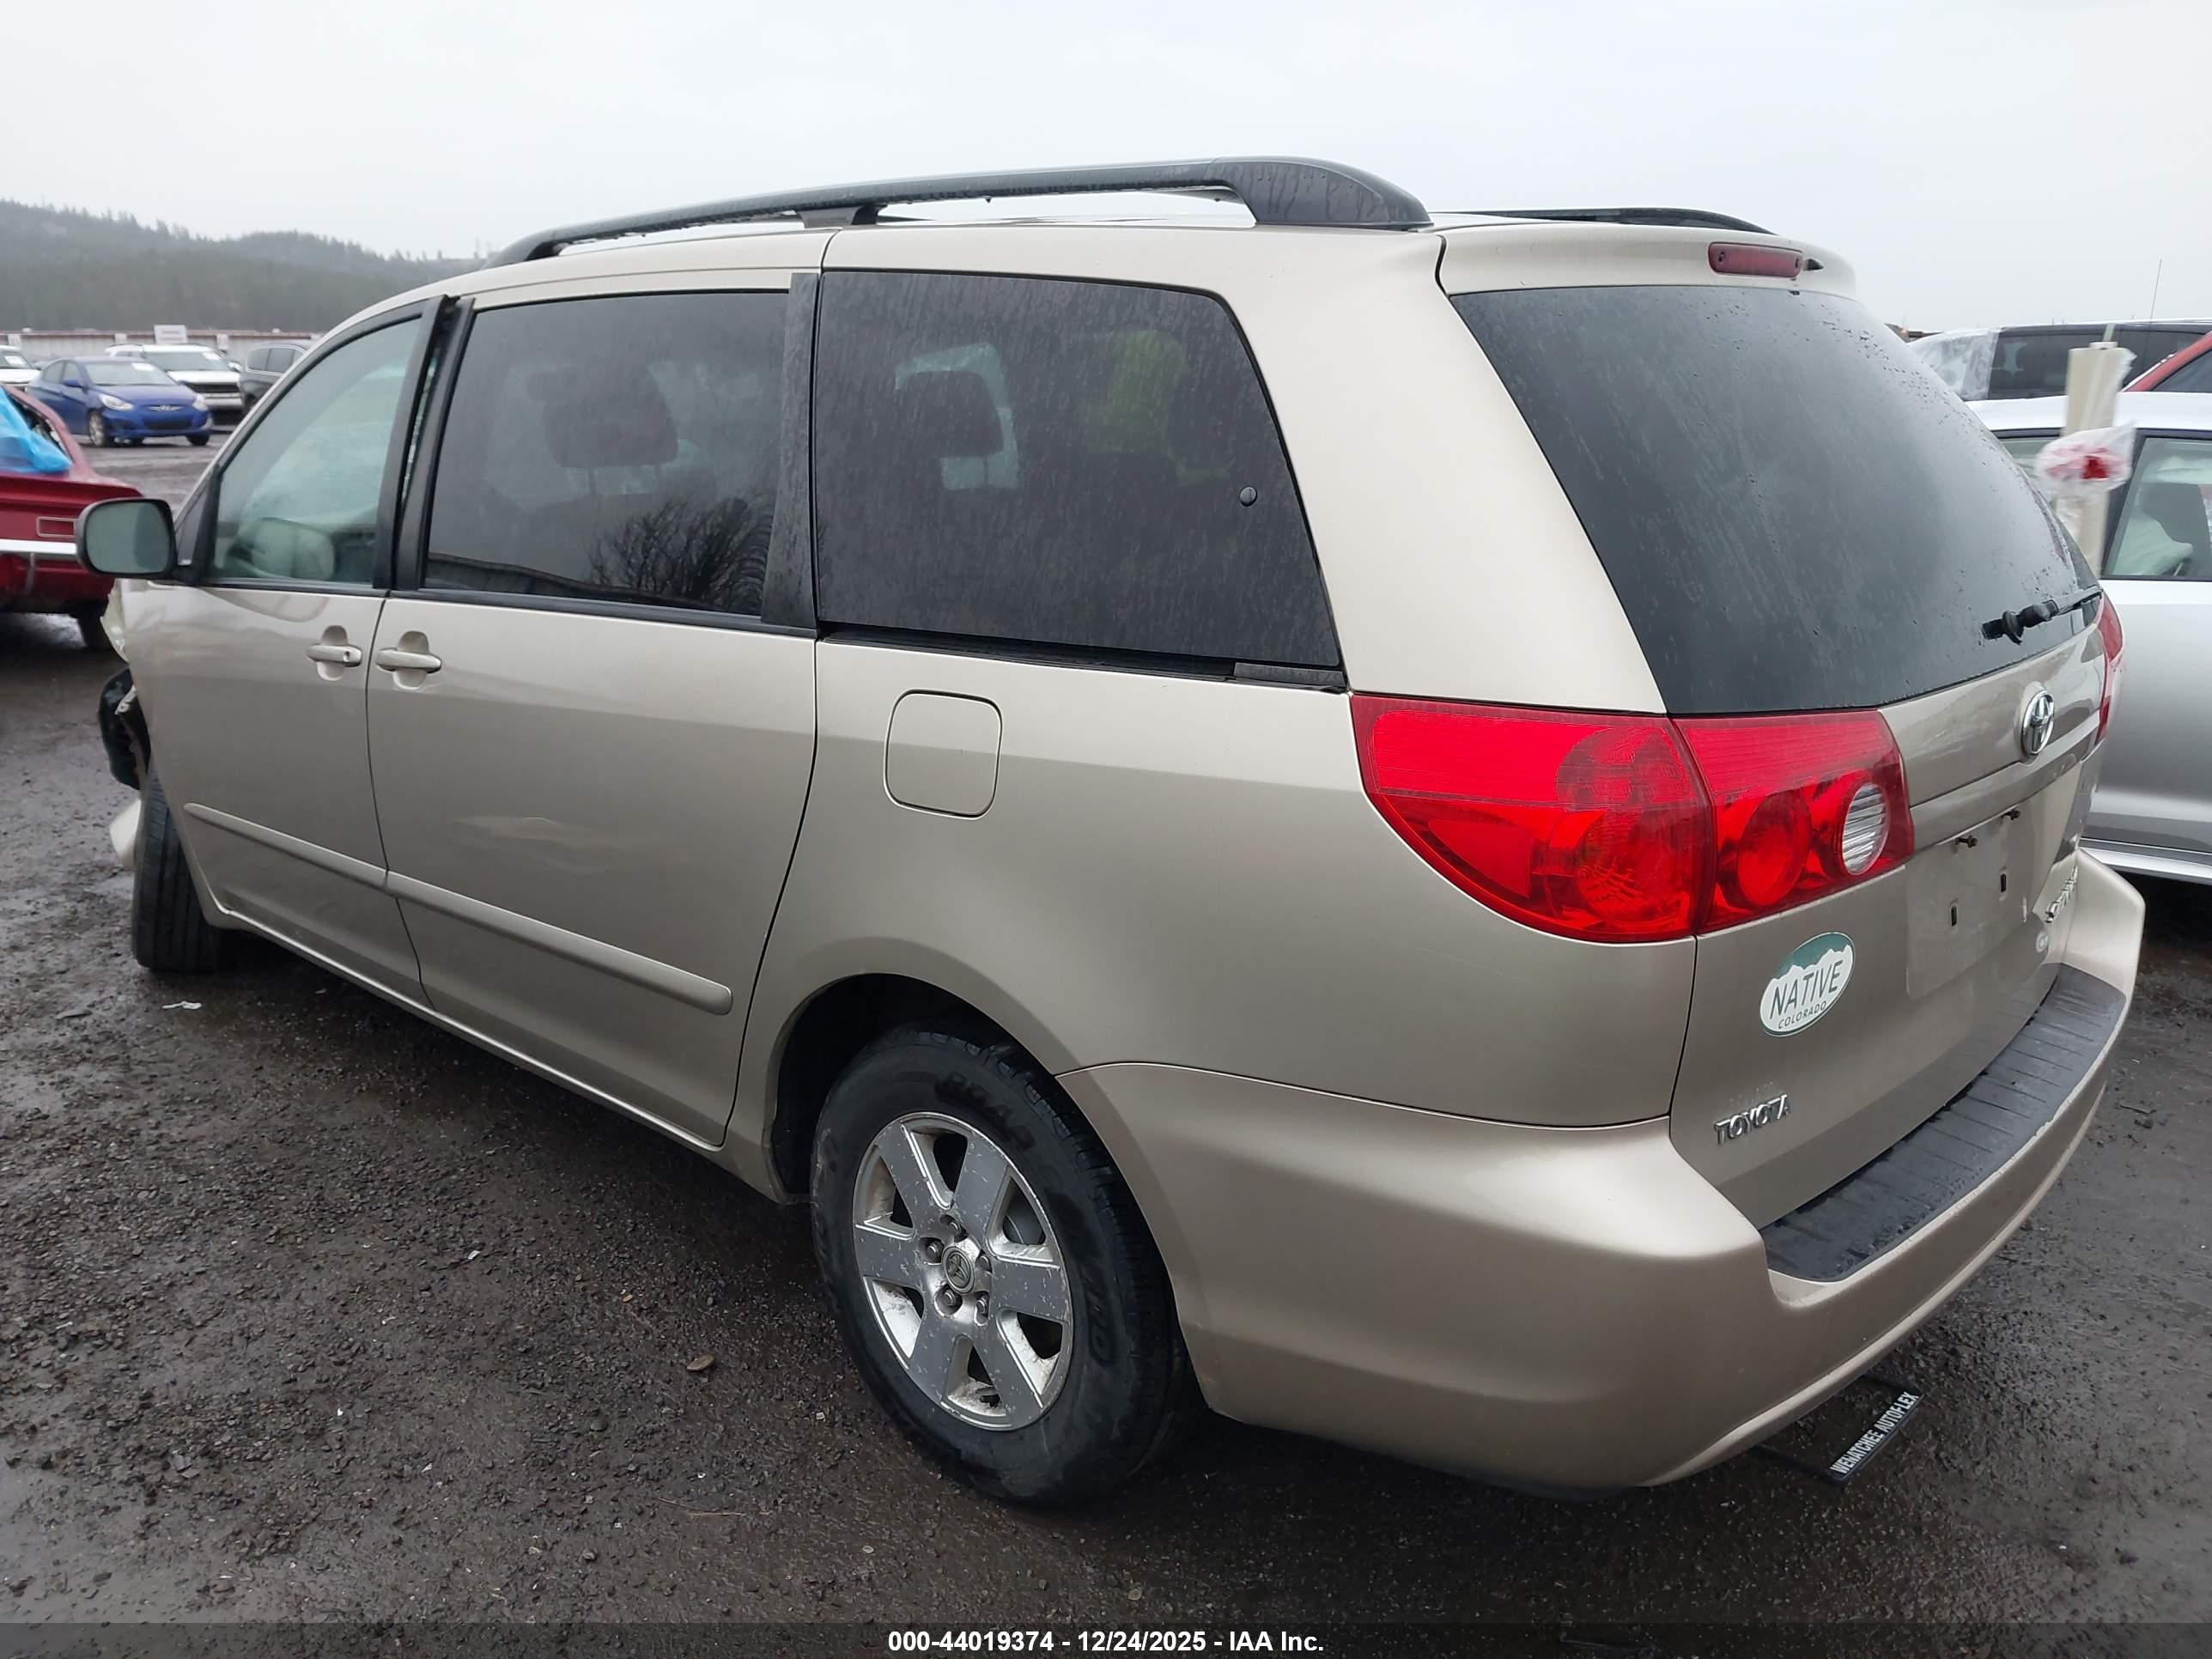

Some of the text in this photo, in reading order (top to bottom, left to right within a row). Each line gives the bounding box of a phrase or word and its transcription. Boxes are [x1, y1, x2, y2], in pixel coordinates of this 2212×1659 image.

[1770, 959, 1844, 1020] NATIVE
[1778, 1000, 1828, 1030] COLORADO
[1715, 1093, 1791, 1145] TOYOTA
[1830, 1390, 1920, 1474] WENATCHEE AUTOFLEX
